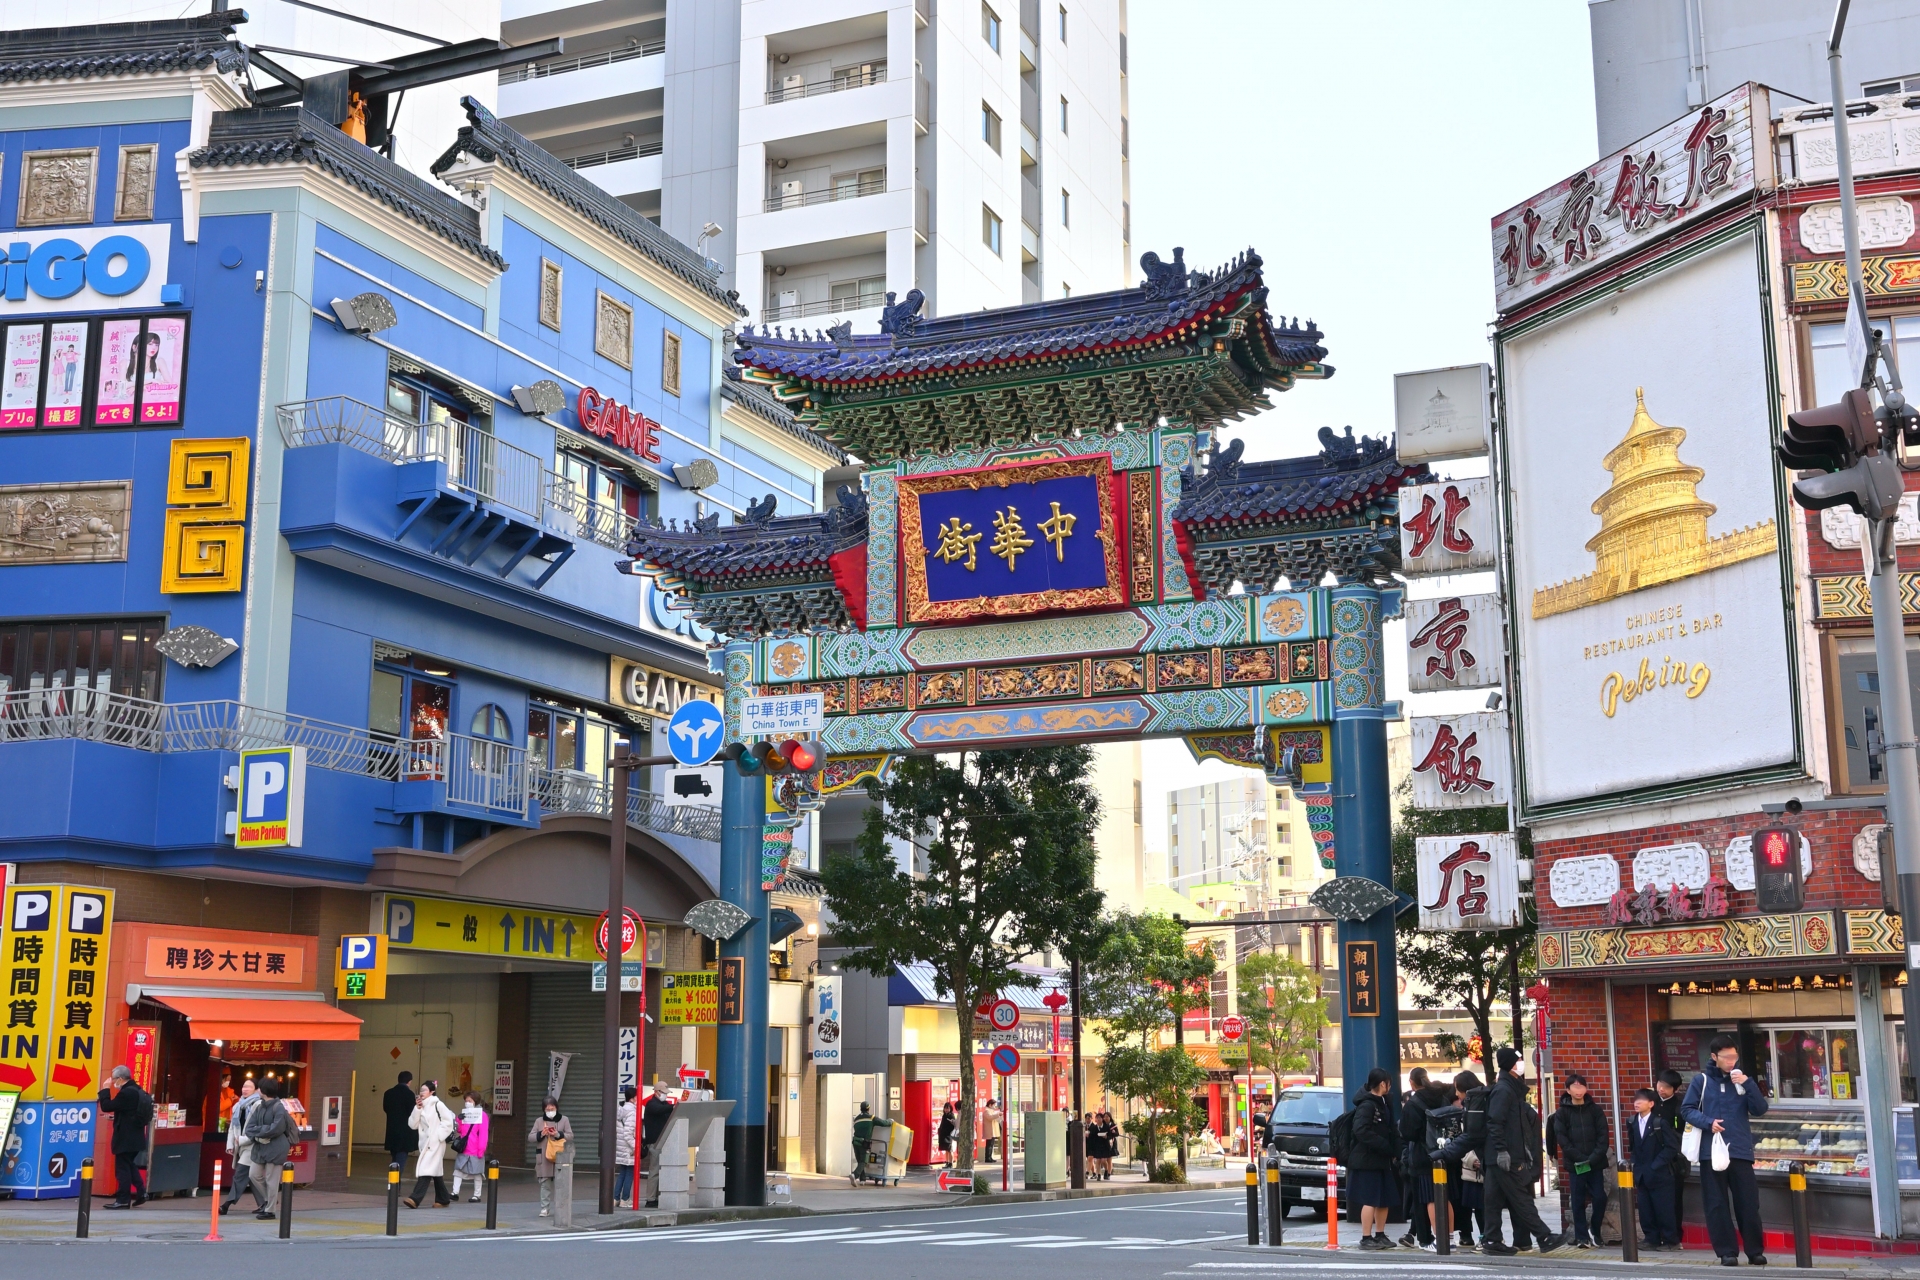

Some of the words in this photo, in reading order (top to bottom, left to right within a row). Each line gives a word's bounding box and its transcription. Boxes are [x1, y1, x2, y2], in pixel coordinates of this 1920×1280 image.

[1500, 106, 1736, 287] 北京飯店
[0, 235, 150, 301] iGO
[48, 410, 76, 423] 撮影
[577, 386, 662, 464] GAME
[1626, 603, 1683, 630] CHINESE
[1583, 625, 1674, 660] RESTAURANT
[1678, 622, 1688, 637] &
[1692, 612, 1723, 634] BAR
[626, 666, 709, 713] GAM
[1402, 485, 1496, 918] 北京飯店
[1600, 655, 1712, 718] Peking
[746, 698, 818, 719] 中華街東門
[752, 719, 776, 730] China
[778, 718, 800, 728] Town
[803, 716, 811, 727] E.
[246, 761, 285, 818] P
[240, 825, 259, 842] China
[260, 824, 286, 841] Parking
[14, 894, 49, 930] P
[71, 895, 103, 931] P
[390, 903, 412, 940] P
[436, 914, 478, 943] 一般
[522, 915, 555, 954] IN
[165, 946, 286, 974] 聘珍大甘栗
[346, 937, 371, 969] P
[7, 936, 44, 1028] 時間貸
[64, 937, 98, 1030] 時間貸
[346, 972, 366, 996] 空
[724, 963, 737, 1015] 朝陽門
[1353, 948, 1370, 1007] 朝陽門
[996, 1008, 1014, 1022] 30
[0, 1034, 39, 1059] IN
[58, 1035, 93, 1060] IN
[814, 1049, 838, 1058] GiGO
[991, 1033, 1019, 1041] ここから
[50, 1107, 91, 1125] GiGO
